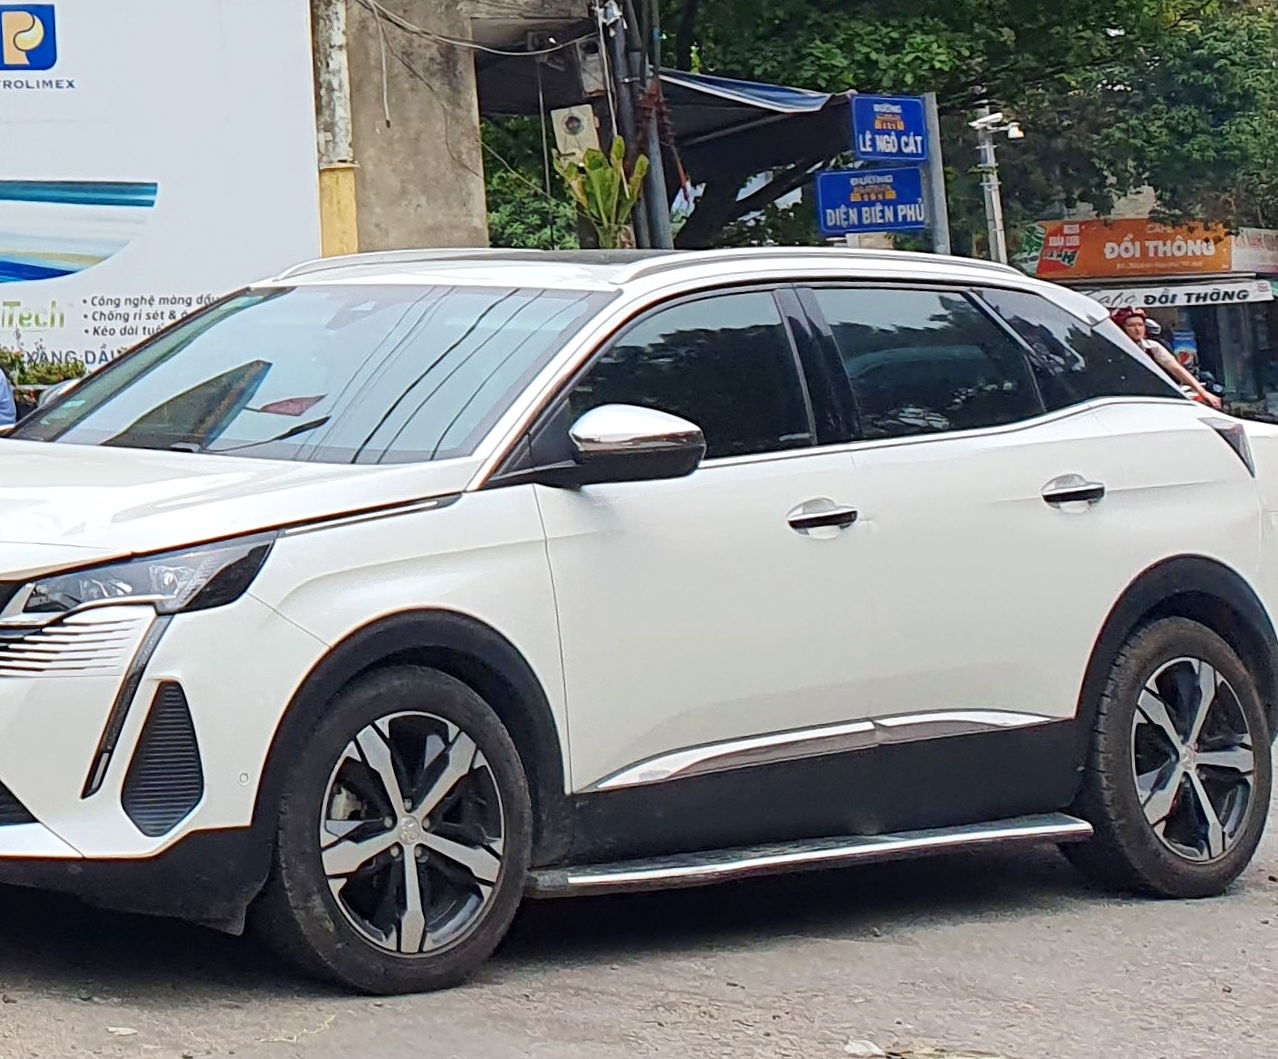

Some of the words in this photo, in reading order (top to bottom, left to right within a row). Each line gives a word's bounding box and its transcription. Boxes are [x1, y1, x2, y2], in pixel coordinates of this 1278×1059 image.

[858, 130, 873, 152] LÊ
[875, 131, 898, 154] NGÔ
[901, 131, 923, 154] CÁT
[861, 202, 894, 224] BIÊN
[897, 197, 925, 222] PHỦ
[1145, 234, 1216, 258] THÔNG
[91, 295, 121, 308] Công
[124, 295, 155, 308] nghệ
[92, 308, 130, 323] Chống
[168, 310, 177, 320] &
[92, 325, 116, 336] Kéo
[119, 324, 138, 336] dài
